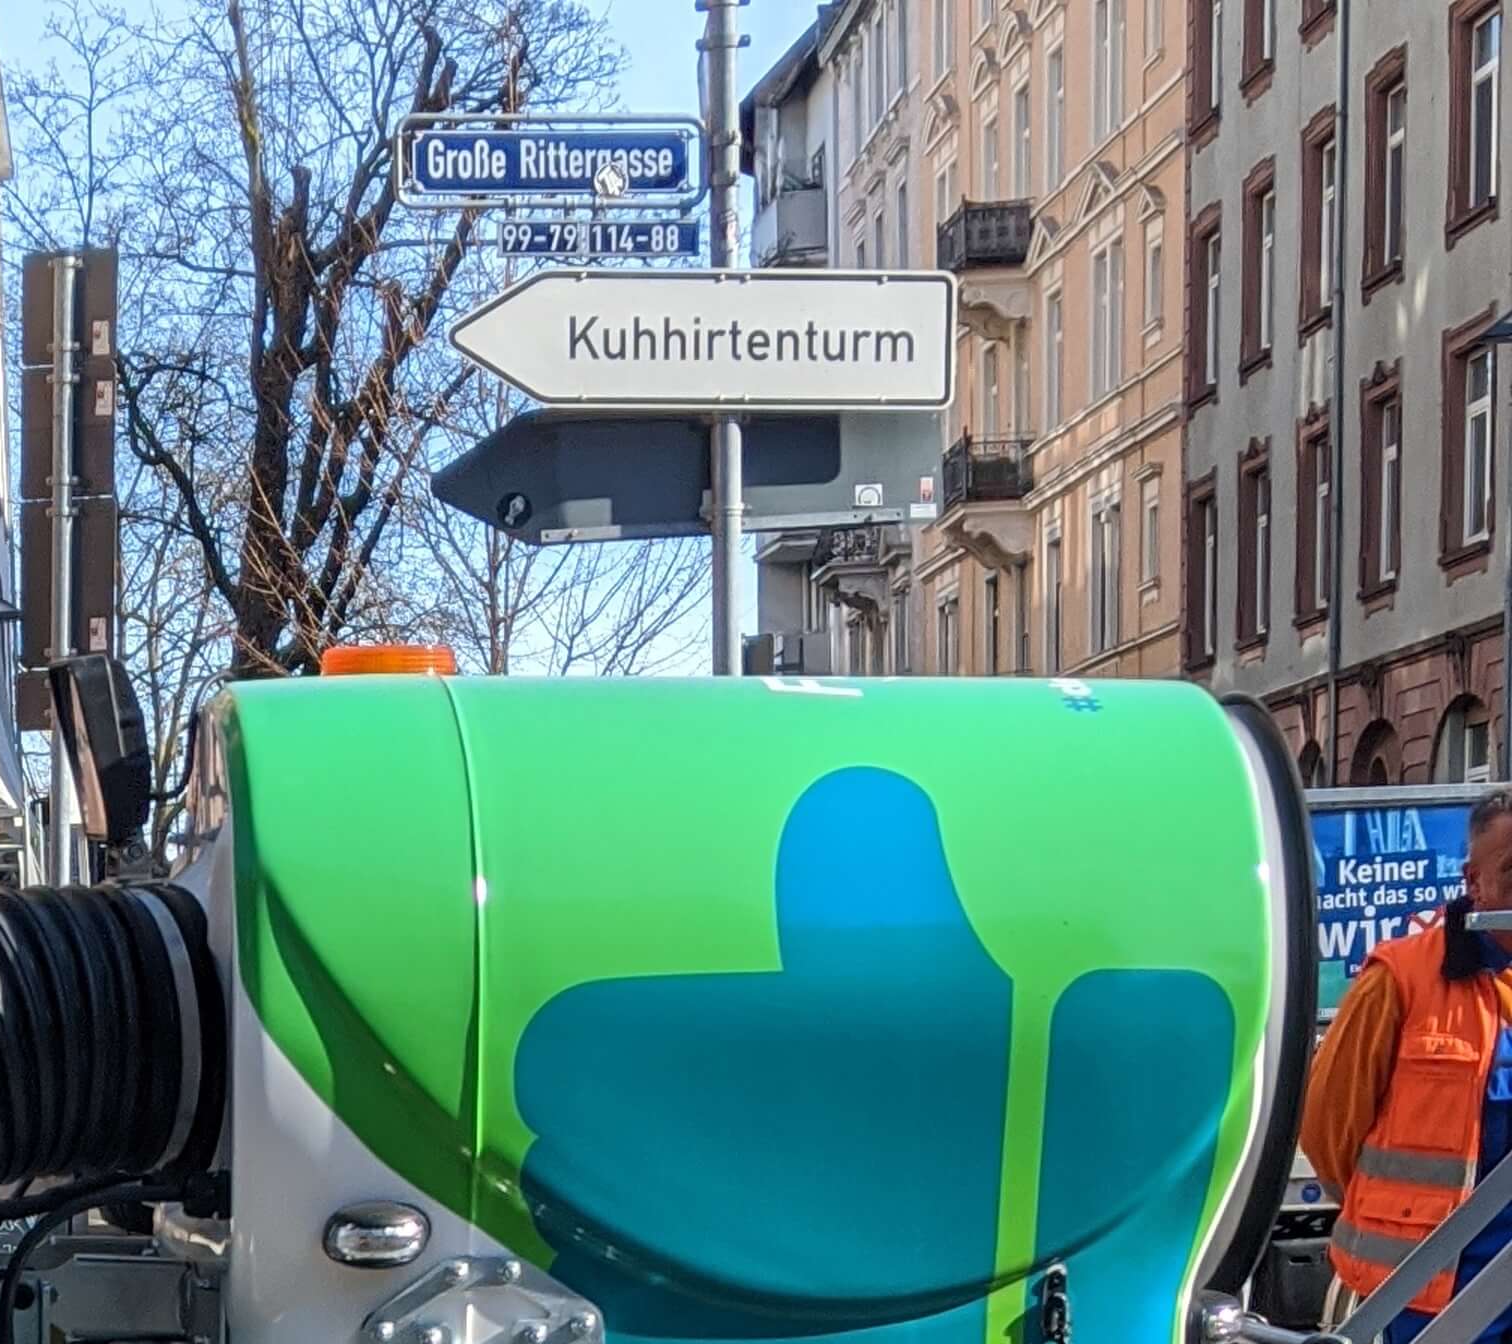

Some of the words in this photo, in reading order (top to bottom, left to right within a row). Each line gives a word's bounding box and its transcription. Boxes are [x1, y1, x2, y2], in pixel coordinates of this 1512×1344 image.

[426, 138, 507, 180] Große
[502, 224, 578, 252] 99-79
[591, 223, 680, 252] 114-88
[568, 315, 915, 362] Kuhhirtenturm
[1338, 855, 1430, 886] Keiner
[1373, 884, 1409, 906] das
[1414, 886, 1438, 903] so
[1317, 904, 1403, 959] wir
